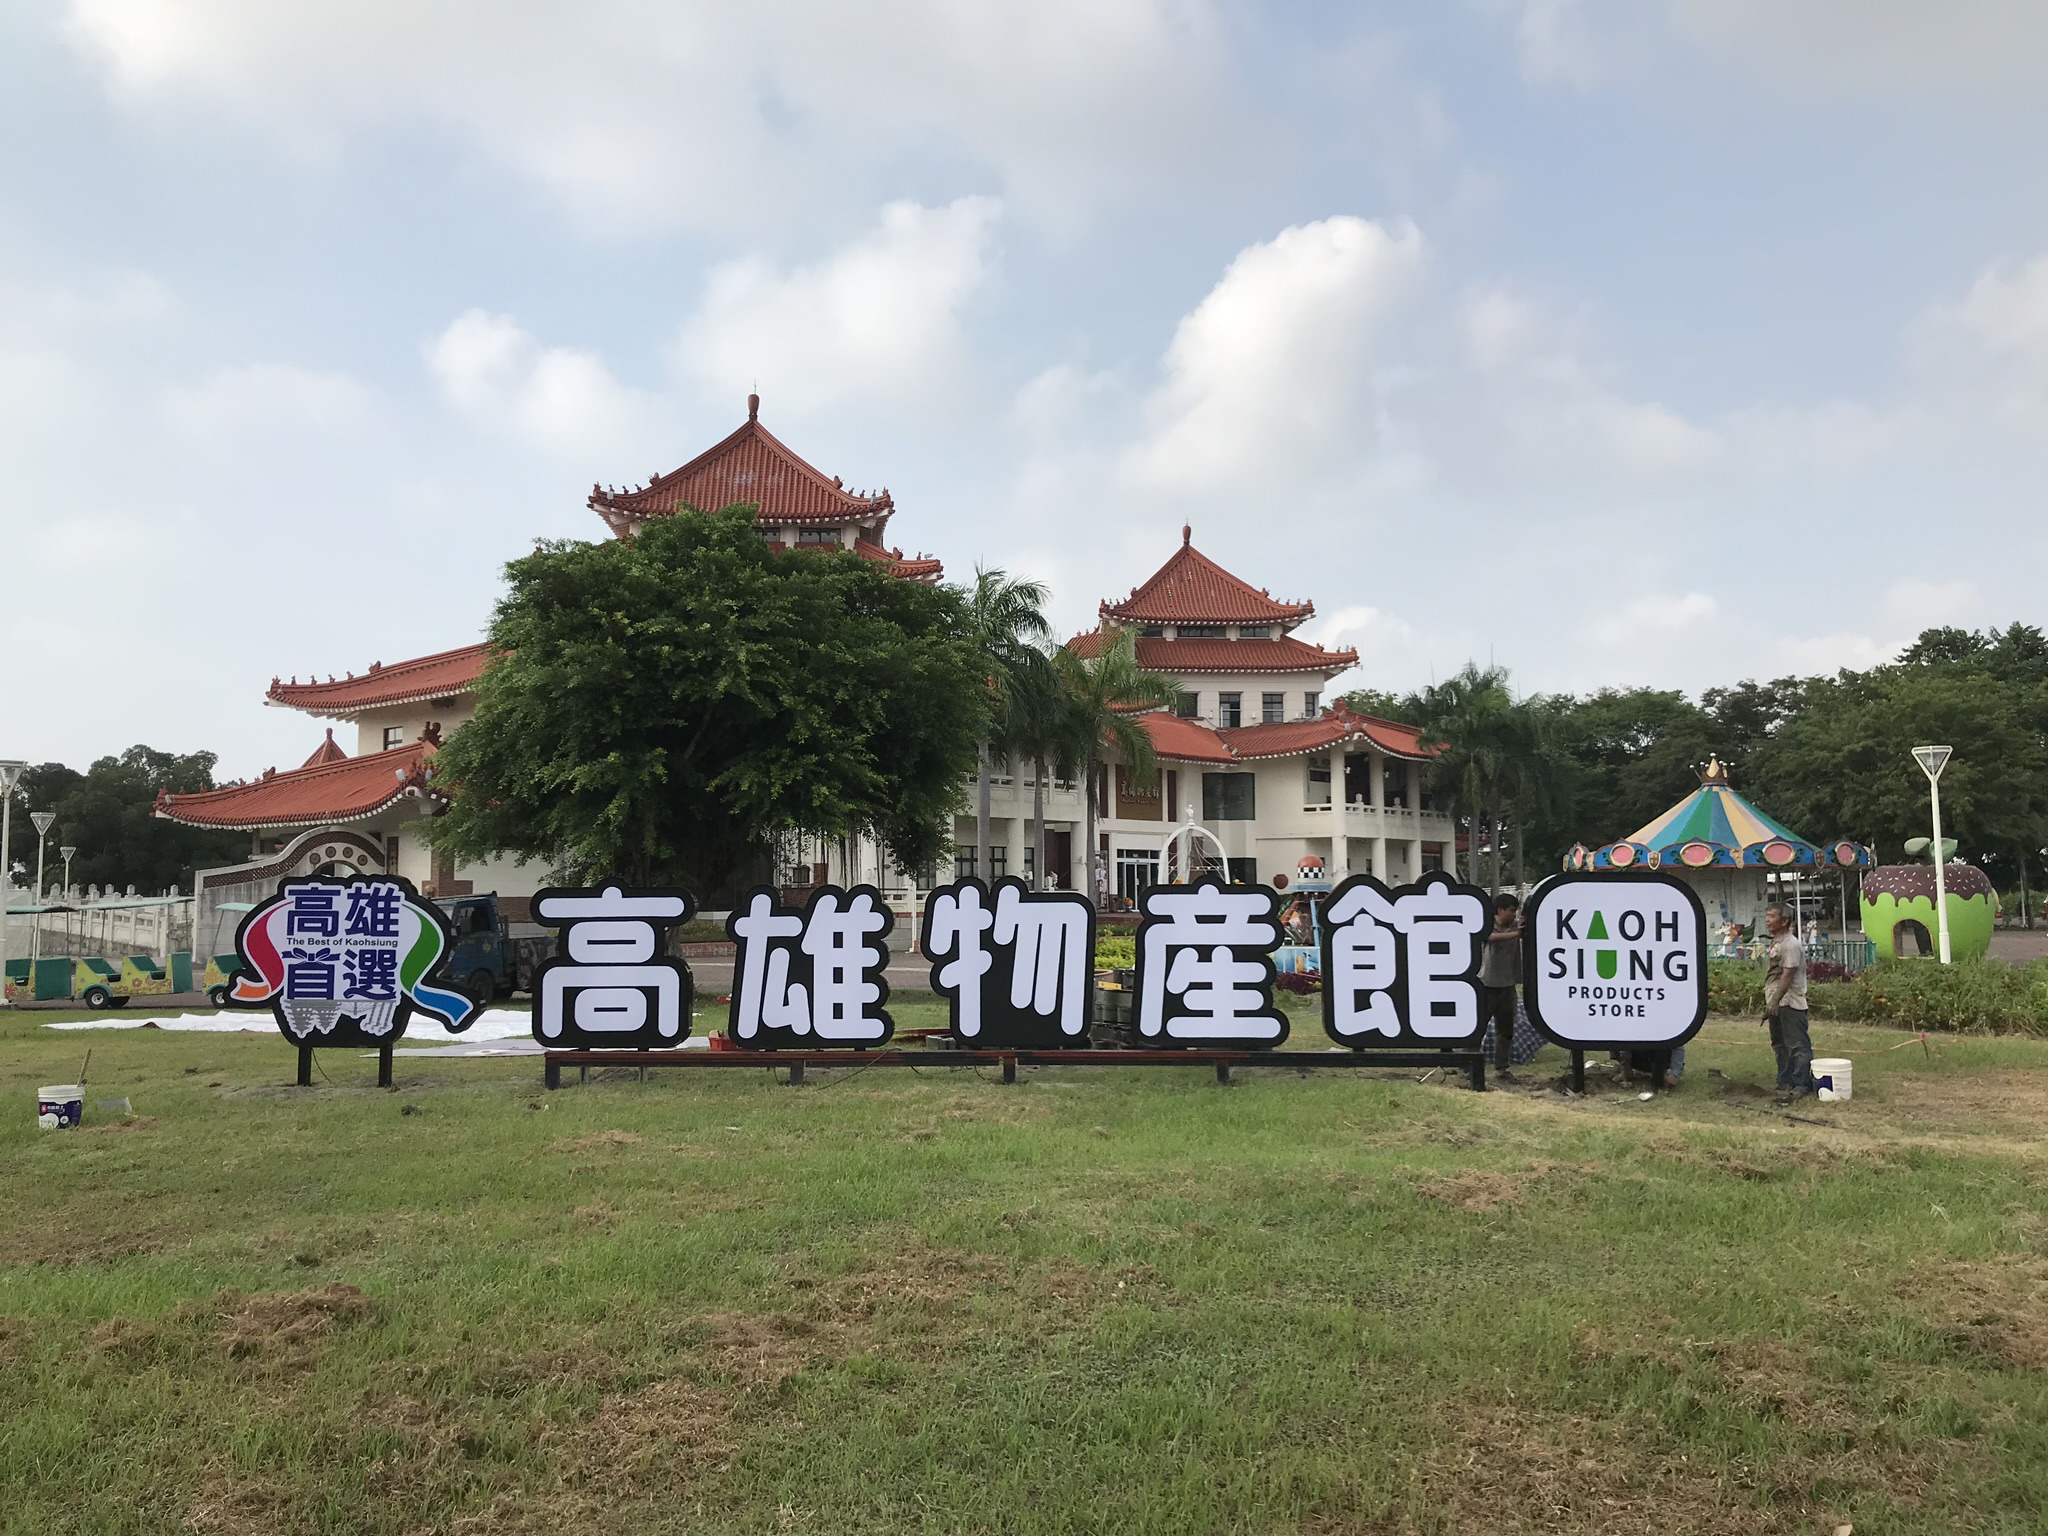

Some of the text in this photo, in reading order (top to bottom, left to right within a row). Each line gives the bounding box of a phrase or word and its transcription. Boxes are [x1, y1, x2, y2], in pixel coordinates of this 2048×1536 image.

[286, 886, 401, 937] 高雄
[1556, 908, 1679, 942] KAOH
[286, 937, 398, 948] The Best of Kaohsiung
[281, 947, 398, 1001] 首選
[1548, 947, 1688, 982] SIUNG
[1568, 986, 1665, 1001] PRODUCTS
[1588, 1003, 1646, 1018] STORE
